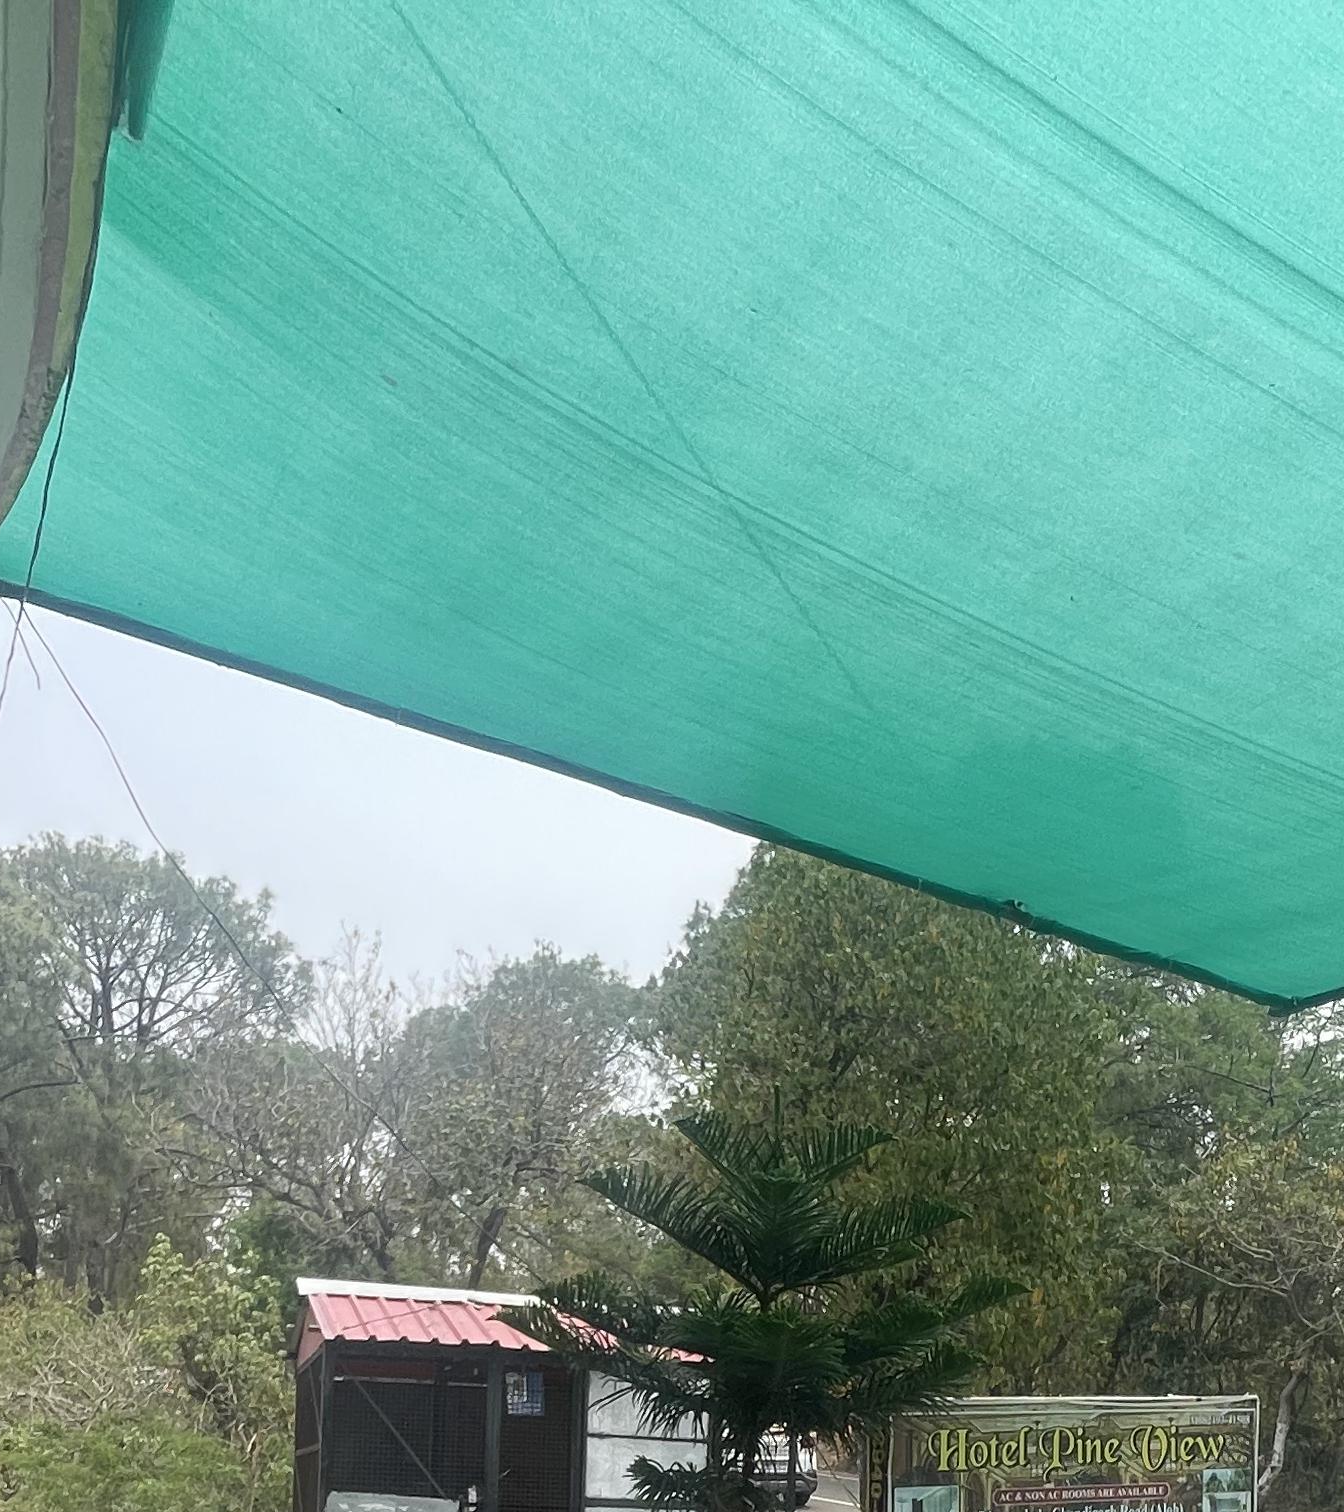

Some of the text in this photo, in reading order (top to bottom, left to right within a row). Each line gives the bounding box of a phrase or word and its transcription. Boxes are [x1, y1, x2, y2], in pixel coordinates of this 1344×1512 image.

[928, 1424, 1225, 1481] Hotel Pine View
[999, 1486, 1165, 1501] AC & NON AC ROOMS ARE AVAILABLE
